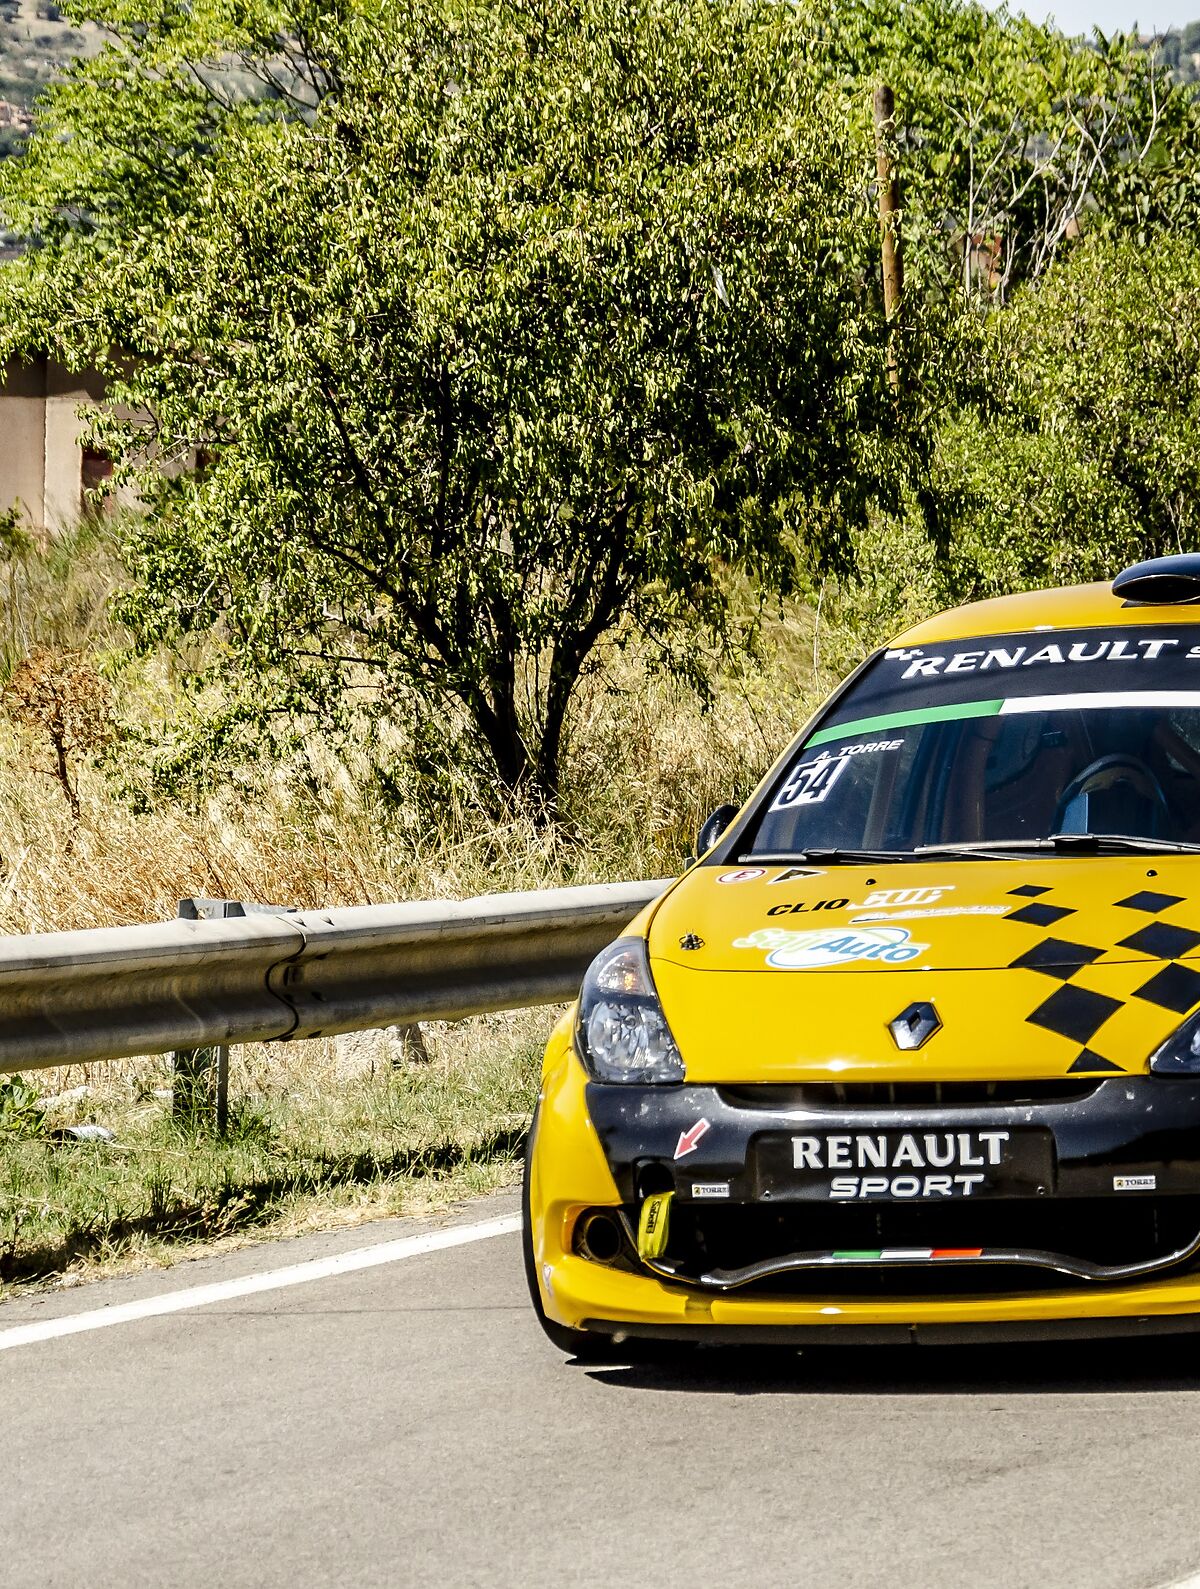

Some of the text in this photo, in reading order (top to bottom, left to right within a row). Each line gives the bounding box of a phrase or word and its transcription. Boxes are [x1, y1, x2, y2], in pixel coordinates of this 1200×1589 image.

[901, 638, 1180, 681] RENAULT
[838, 739, 905, 757] TORRE
[777, 757, 844, 806] 54
[767, 899, 850, 916] CLIO
[791, 1132, 1009, 1169] RENAULT
[829, 1174, 985, 1198] SPORT
